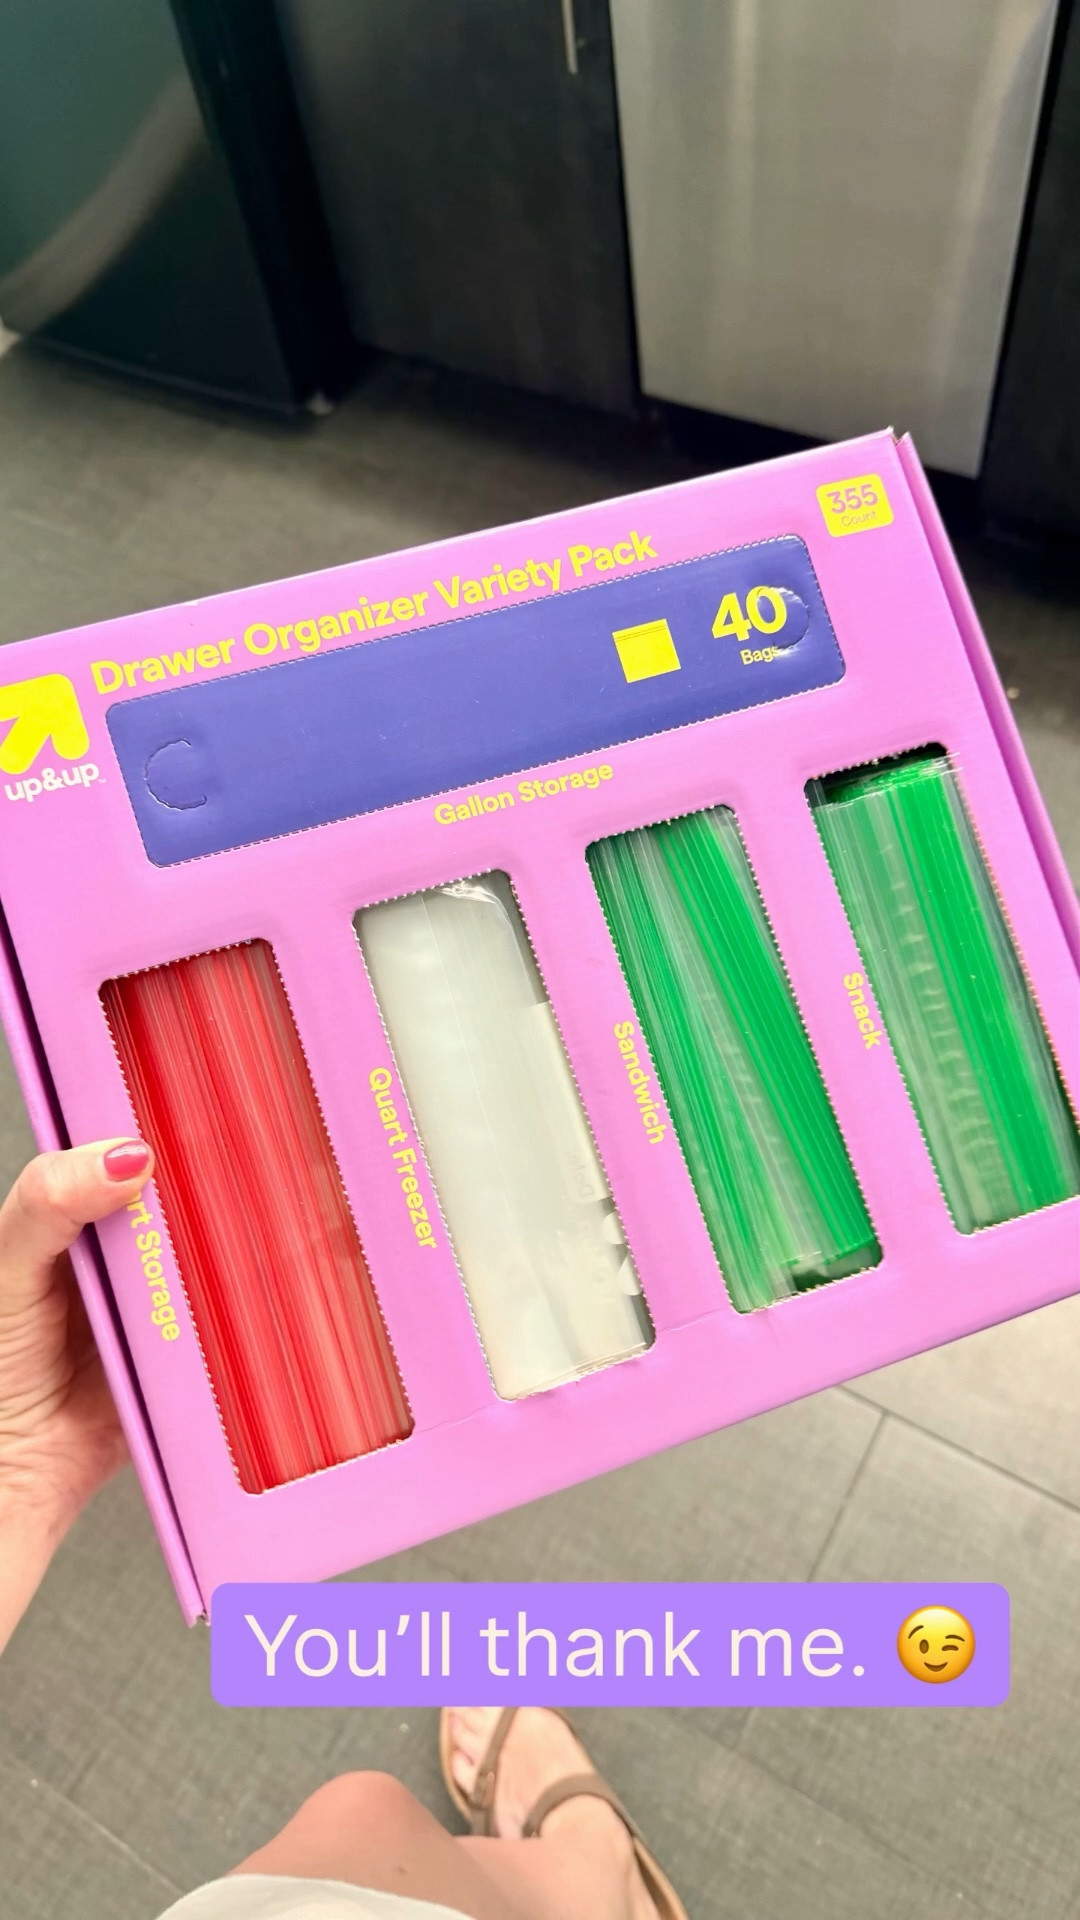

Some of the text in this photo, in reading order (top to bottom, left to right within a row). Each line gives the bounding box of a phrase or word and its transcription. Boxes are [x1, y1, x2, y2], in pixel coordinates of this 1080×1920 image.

[826, 484, 878, 514] 355
[842, 510, 877, 527] Count
[90, 530, 657, 694] Drawer Organizer Variety Pack
[711, 585, 787, 641] 40
[740, 646, 780, 665] Bags
[4, 763, 99, 802] up&up
[434, 764, 613, 825] Gallon Storage
[843, 972, 881, 1048] Snack
[613, 1021, 666, 1144] Sandwich
[369, 1067, 437, 1249] Quart Freezer
[135, 1230, 180, 1341] Storage
